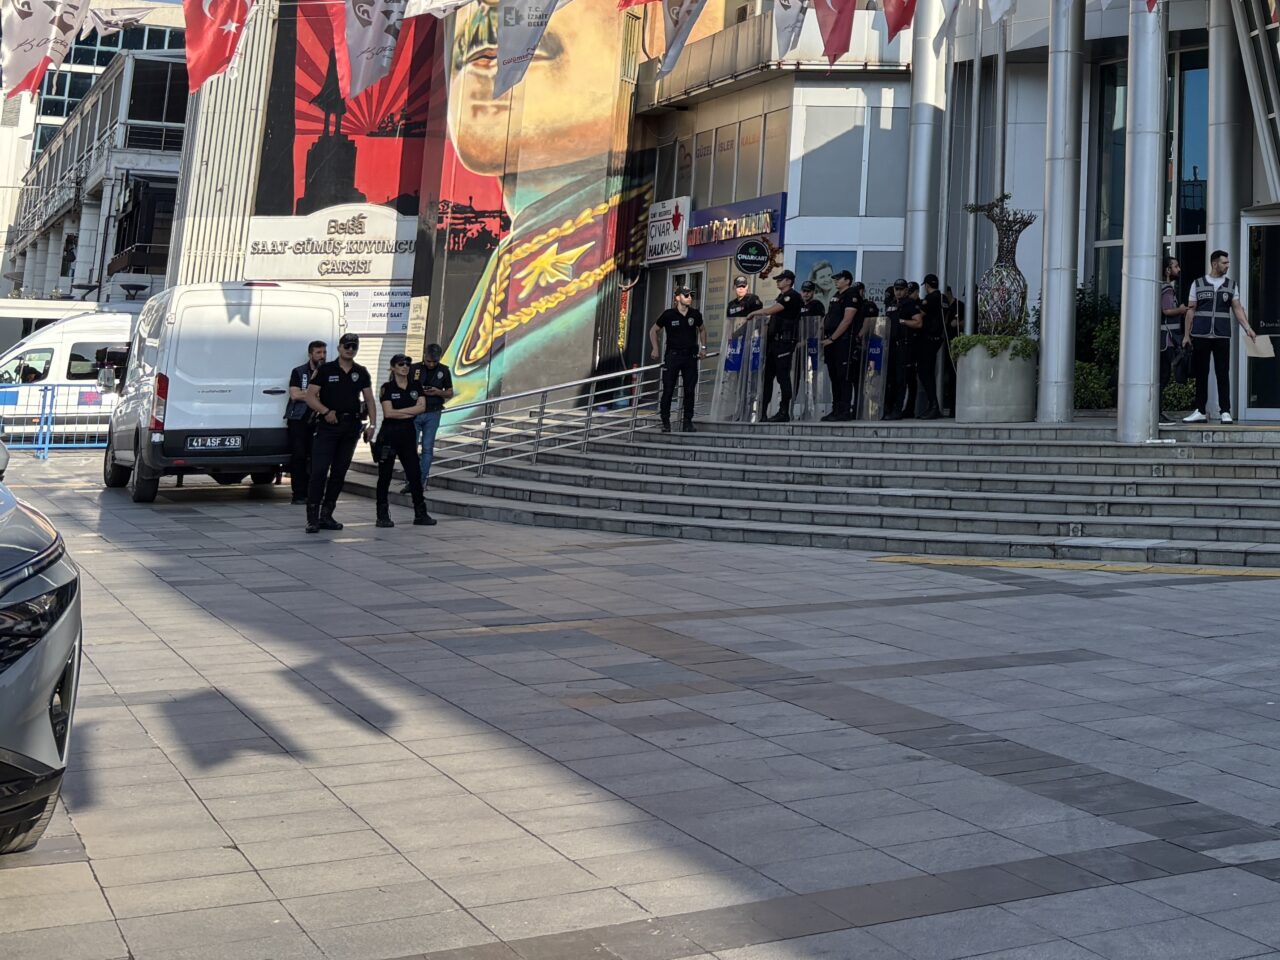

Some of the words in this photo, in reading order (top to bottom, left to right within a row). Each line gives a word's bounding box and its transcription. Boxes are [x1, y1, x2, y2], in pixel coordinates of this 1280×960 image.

[649, 240, 681, 257] HALKMASA
[192, 437, 202, 446] 41
[206, 437, 221, 447] ASF
[224, 436, 240, 446] 493
